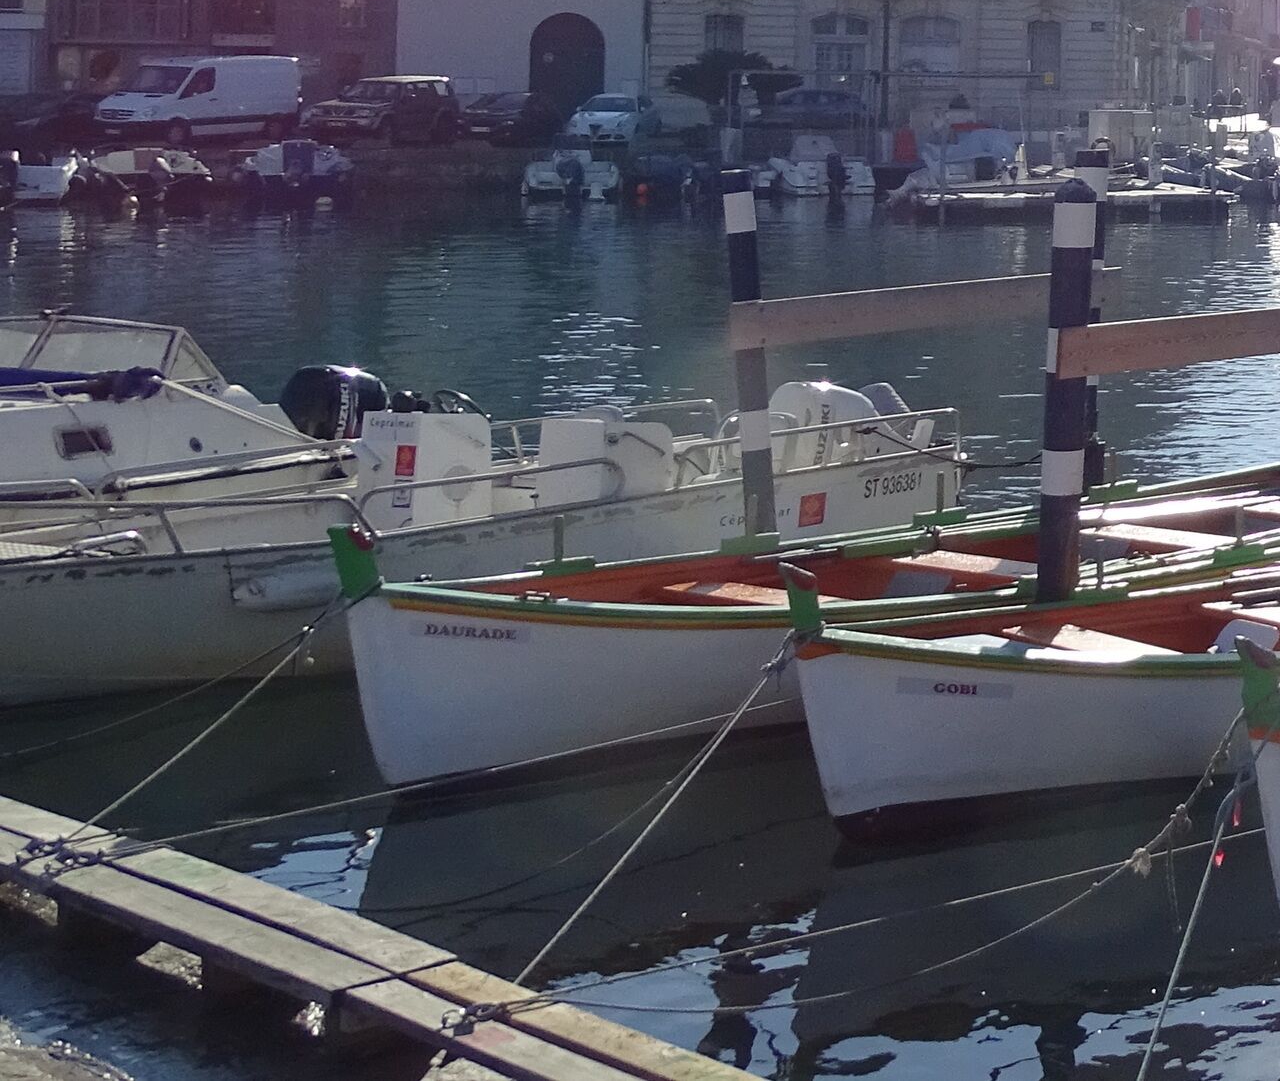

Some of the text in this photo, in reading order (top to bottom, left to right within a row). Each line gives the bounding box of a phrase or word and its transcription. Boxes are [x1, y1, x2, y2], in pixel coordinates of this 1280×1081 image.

[335, 383, 350, 439] SUZUKI
[864, 471, 922, 499] ST 936381
[424, 623, 517, 639] DAURADE
